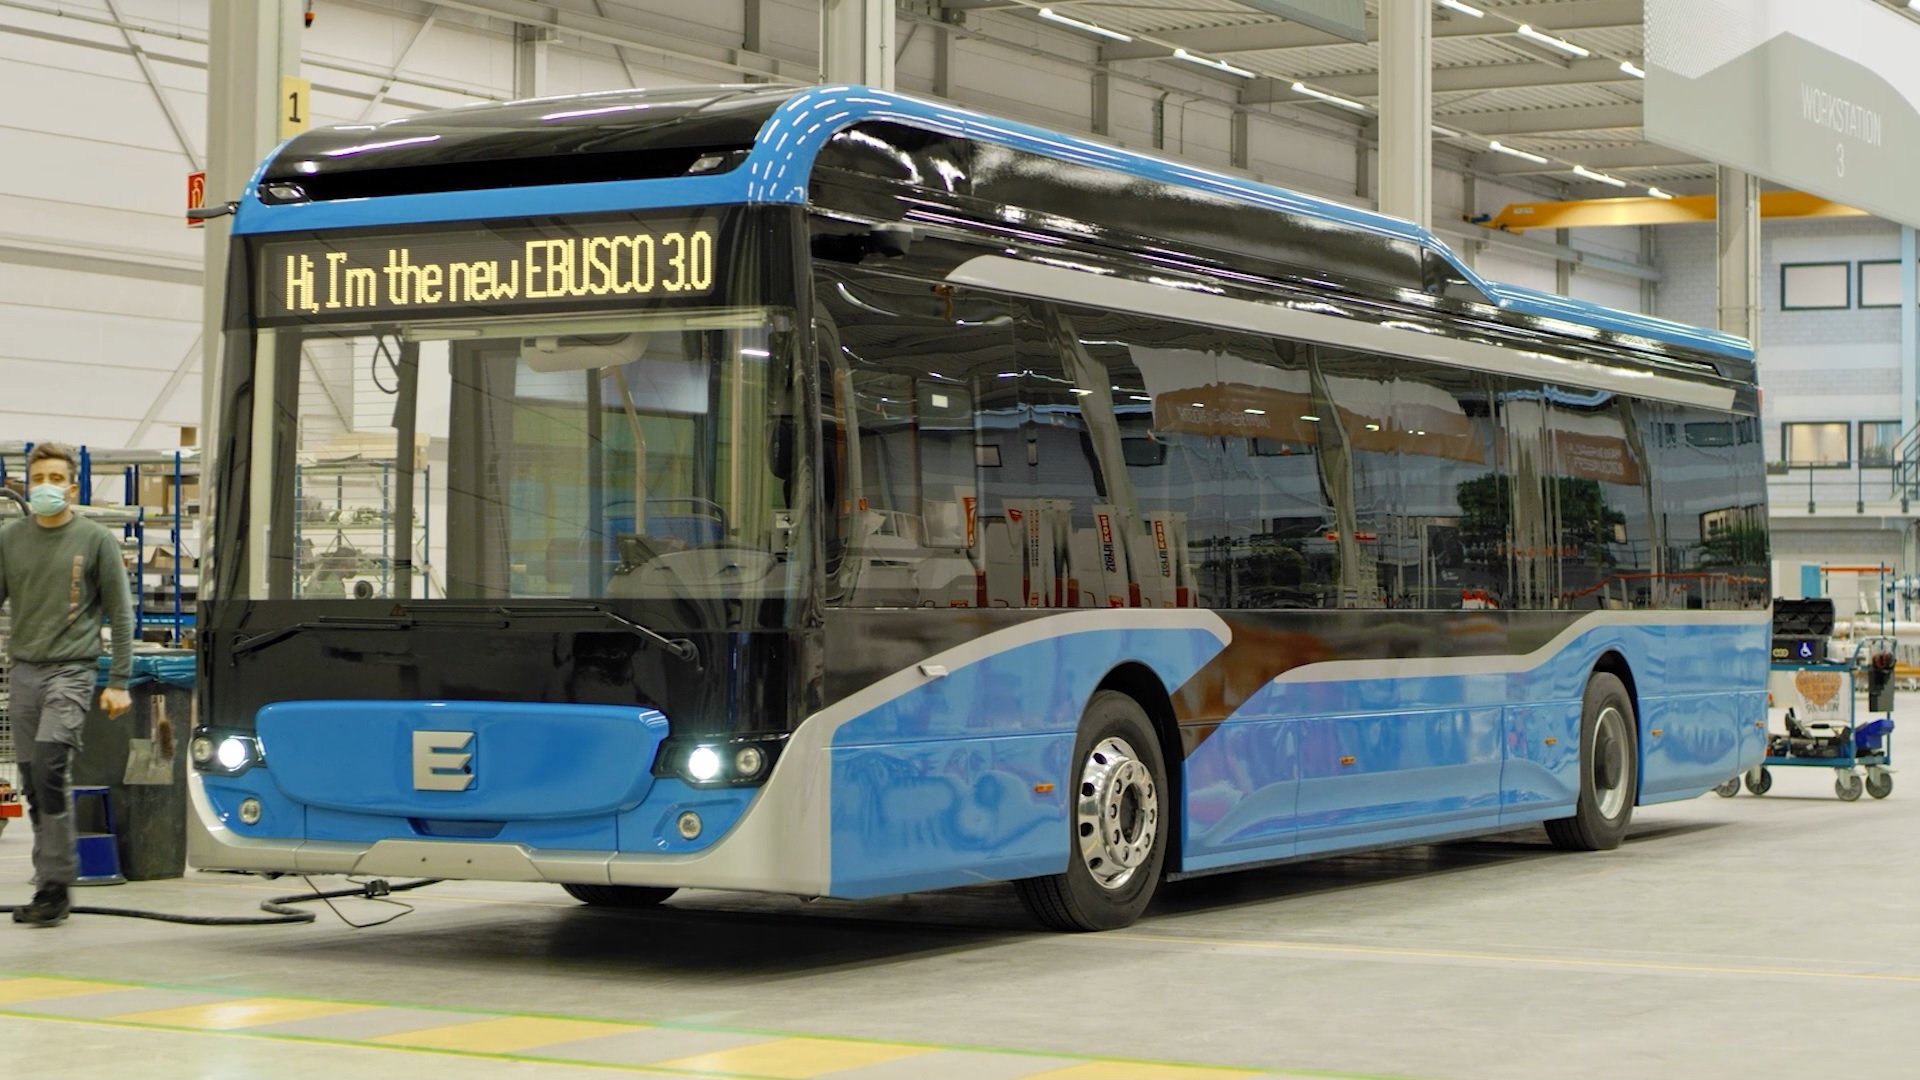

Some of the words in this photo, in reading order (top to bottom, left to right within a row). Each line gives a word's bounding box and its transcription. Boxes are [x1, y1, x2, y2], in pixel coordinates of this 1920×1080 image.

[289, 92, 301, 123] 1
[1801, 83, 1880, 147] WORKSTATION
[1836, 143, 1844, 178] 3
[287, 254, 319, 314] Hi,
[326, 252, 377, 308] I'm
[383, 248, 443, 305] the
[449, 259, 519, 302] new
[525, 234, 655, 298] EBUSCO
[662, 231, 712, 291] 3.0
[412, 731, 475, 791] E
